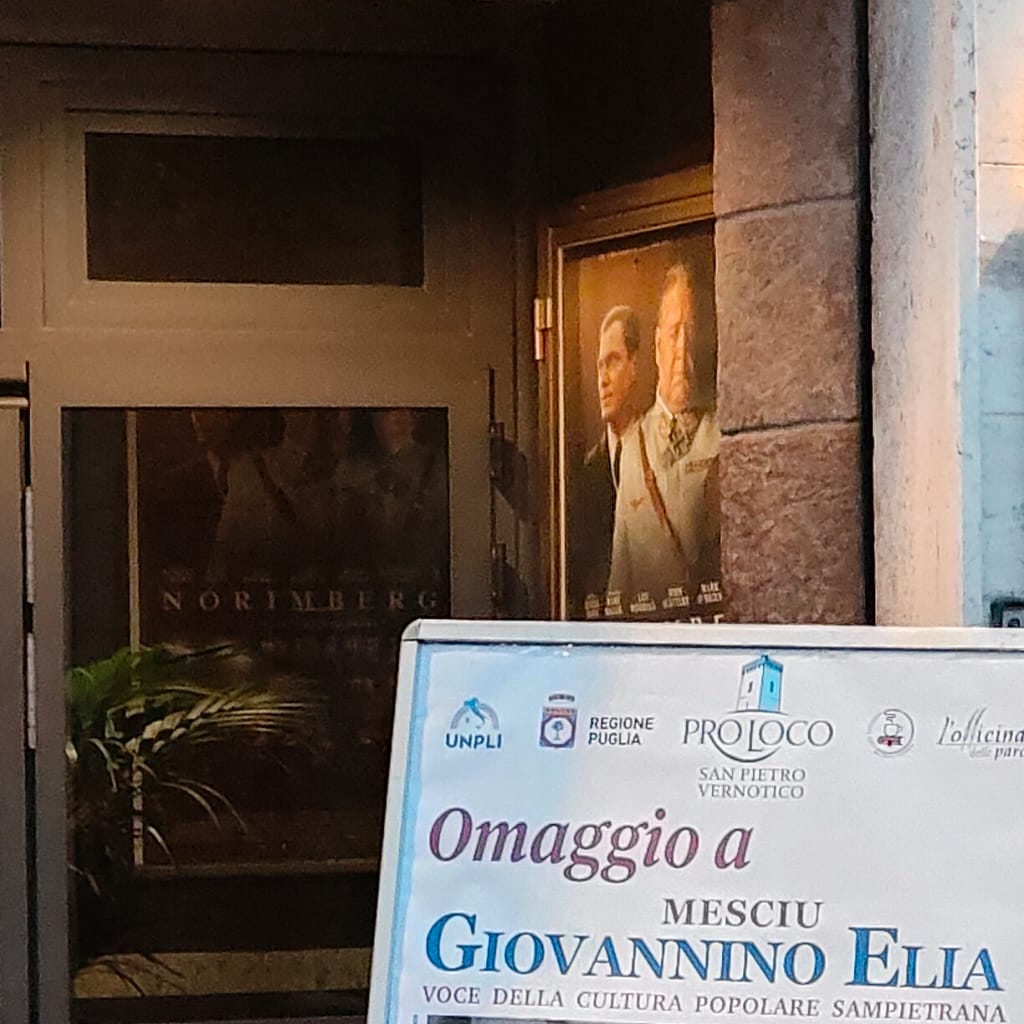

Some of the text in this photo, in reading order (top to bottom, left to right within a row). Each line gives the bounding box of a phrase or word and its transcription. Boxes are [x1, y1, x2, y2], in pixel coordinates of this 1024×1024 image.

[589, 716, 654, 731] REGIONE
[446, 733, 502, 749] UNPLI
[588, 731, 641, 746] PUGLIA
[699, 767, 806, 783] SAN PIETRO
[699, 784, 804, 799] VERNOTICO
[429, 808, 753, 884] Omaggio a
[661, 899, 824, 928] MESCIU
[426, 913, 1005, 991] GIOVANNINO ELIA
[423, 986, 1006, 1024] VOCE DELLA CULTURA POPOLARE SAMPIETRANA
